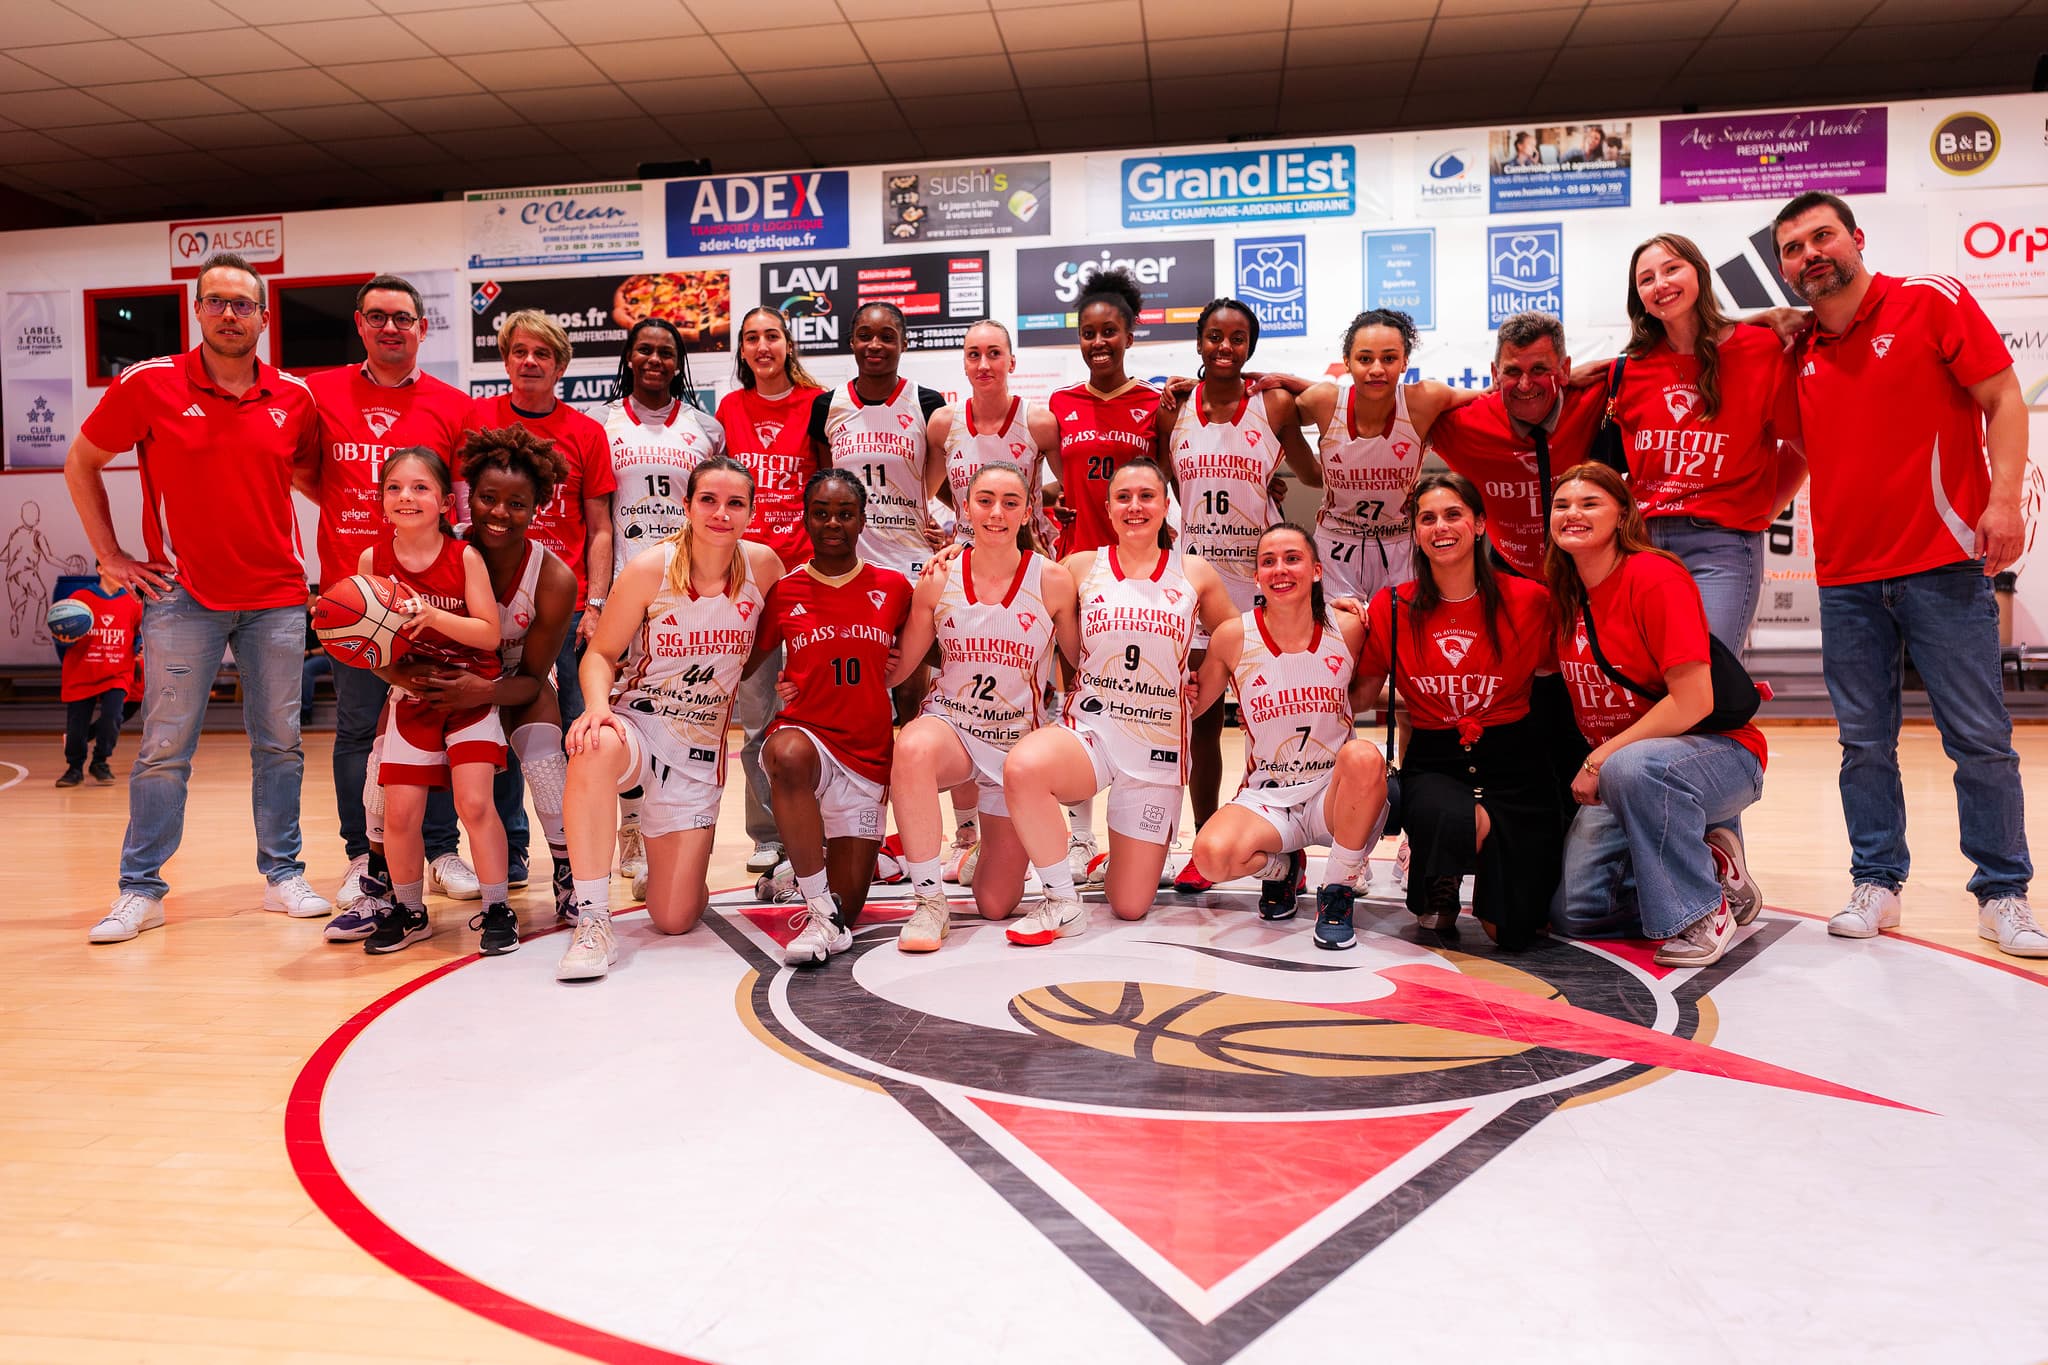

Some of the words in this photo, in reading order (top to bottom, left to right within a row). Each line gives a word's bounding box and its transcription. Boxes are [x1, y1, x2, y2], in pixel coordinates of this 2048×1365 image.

[1736, 141, 1810, 156] RESTAURANT
[1939, 130, 1993, 155] B&B
[1946, 153, 1984, 163] HOTELS
[930, 168, 1008, 195] sushi's
[1421, 183, 1482, 196] Homiris
[690, 174, 824, 224] ADEX
[1128, 208, 1170, 222] ALSACE
[1172, 202, 1294, 219] CHAMPAGNE-ARDENNE
[1296, 198, 1349, 213] LORRAINE
[690, 223, 749, 236] TRANSPORT
[763, 218, 824, 232] LOGISTIQUE
[212, 229, 275, 250] ALSACE
[699, 232, 816, 252] adex-logistique.fr
[1386, 258, 1412, 268] Active
[1382, 279, 1416, 290] Sportive
[1491, 290, 1560, 313] Illkirch
[492, 307, 607, 332] dnos.fr
[791, 315, 838, 341] IEN
[18, 336, 24, 345] 3
[26, 335, 62, 345] ÉTOILES
[24, 326, 55, 336] LABEL
[17, 434, 66, 443] FORMATEUR
[836, 436, 852, 448] SIG
[856, 432, 914, 451] ILLKIRCH
[1634, 429, 1730, 454] OBJECTIF
[615, 447, 634, 461] SIG
[638, 446, 697, 465] ILLKIRCH
[735, 452, 804, 473] OBJECTIF
[835, 444, 915, 461] GRAFFENSTADEN
[951, 466, 965, 480] SIG
[1088, 456, 1115, 480] 20
[1179, 456, 1194, 472] SIG
[1198, 454, 1262, 474] ILLKIRCH
[1327, 469, 1345, 481] SIG
[1349, 467, 1415, 481] ILLKIRCH
[862, 464, 886, 486] 11
[1180, 467, 1262, 485] GRAFFENSTADEN
[645, 475, 670, 497] 15
[620, 504, 651, 516] Crédit
[666, 505, 685, 516] Mut
[882, 495, 917, 508] Mutuel
[1203, 490, 1229, 515] 16
[1356, 500, 1385, 521] 27
[342, 508, 370, 522] geiger
[865, 513, 916, 526] Homiris
[1184, 522, 1206, 535] Crédit
[1221, 524, 1262, 537] Mutuel
[1202, 545, 1257, 557] Homiris
[1086, 607, 1108, 627] SIG
[1114, 606, 1186, 633] ILLKIRCH
[657, 633, 682, 647] SIG
[689, 629, 754, 646] ILLKIRCH
[1085, 619, 1185, 645] GRAFFENSTADEN
[1432, 631, 1442, 639] SIG
[1443, 628, 1478, 638] ASSOCIATION
[791, 633, 808, 654] SIG
[944, 638, 962, 652] SIG
[965, 638, 1034, 660] ILLKIRCH
[1124, 644, 1141, 671] 9
[682, 664, 714, 687] 44
[830, 657, 861, 687] 10
[1082, 672, 1118, 691] Crédit
[970, 674, 997, 701] 12
[1410, 673, 1503, 696] OBJECTIF
[1250, 693, 1274, 713] SIG
[1278, 686, 1345, 705] ILLKIRCH
[1577, 683, 1621, 709] LF2
[934, 694, 968, 714] Crédit
[983, 706, 1025, 721] Mutuel
[1110, 700, 1173, 721] Homiris
[1252, 701, 1345, 724] GRAFFENSTADEN
[958, 721, 1021, 740] Homiris
[1295, 726, 1312, 752] 7
[1258, 759, 1289, 772] Crédit
